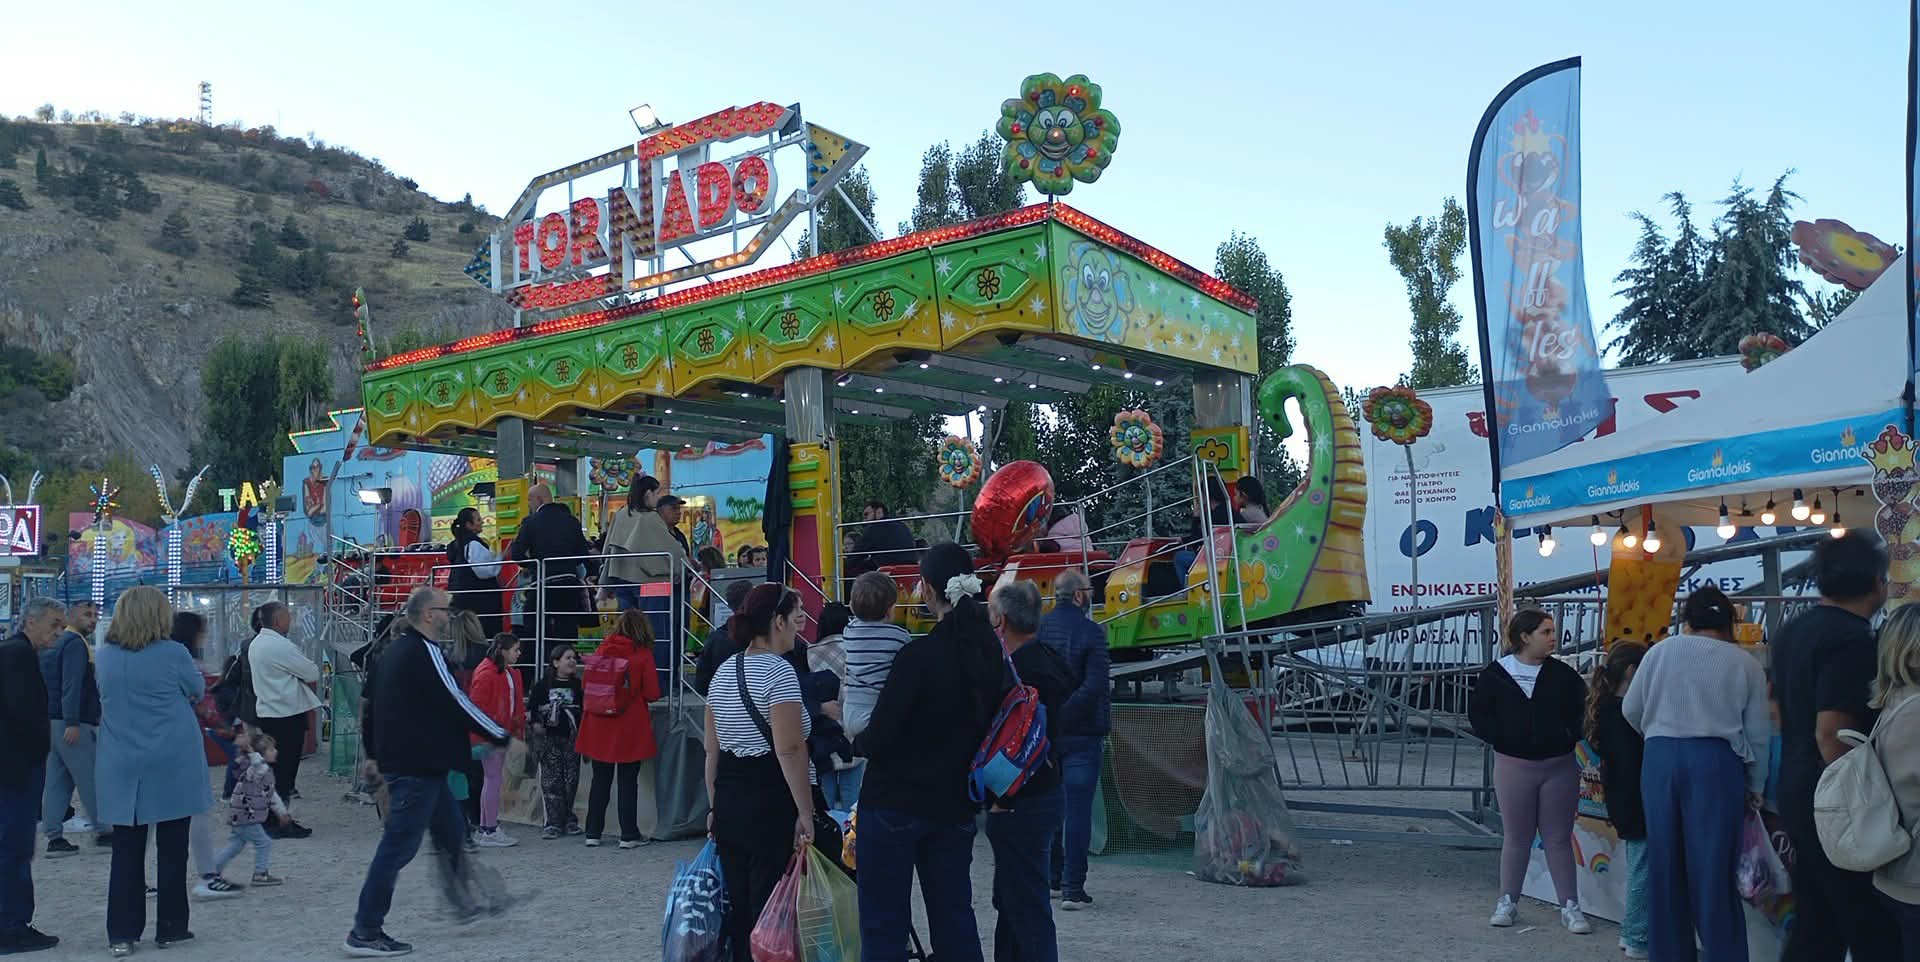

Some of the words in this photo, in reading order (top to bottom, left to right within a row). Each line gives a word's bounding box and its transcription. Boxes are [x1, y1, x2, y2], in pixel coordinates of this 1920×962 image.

[512, 150, 780, 286] TORNADO
[1508, 408, 1599, 435] Giannoulakis
[1811, 441, 1867, 464] Giannoul
[1687, 459, 1751, 482] Giannoulakis
[1414, 487, 1456, 496] ΟΥΚΑΝΙΚΟ
[1425, 495, 1457, 503] ΧΟΝΤΡΟ
[1588, 479, 1640, 498] Giannoulakis
